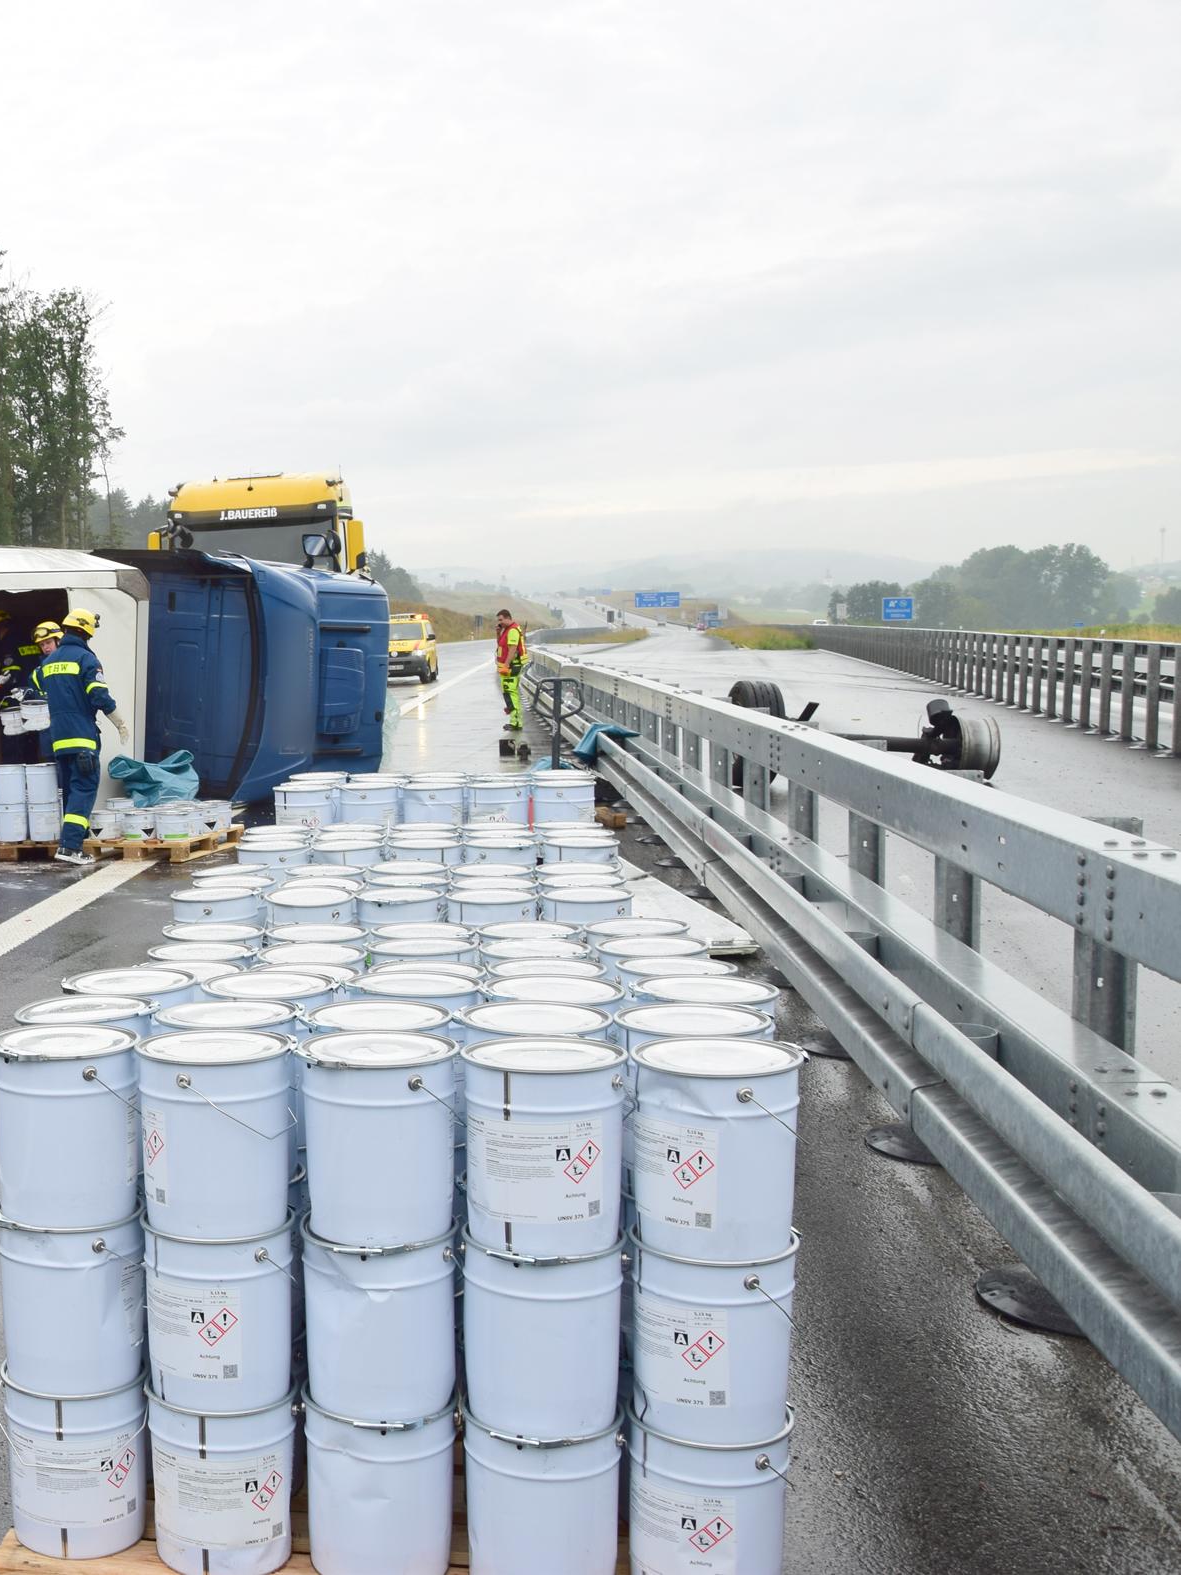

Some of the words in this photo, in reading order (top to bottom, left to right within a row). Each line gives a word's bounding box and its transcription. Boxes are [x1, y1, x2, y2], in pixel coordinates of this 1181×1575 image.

[219, 507, 278, 521] J.BAUEREIß
[46, 663, 69, 674] THW
[557, 1149, 570, 1161] A
[668, 1150, 679, 1163] A
[679, 1218, 690, 1226] 375
[192, 1312, 204, 1323] A
[675, 1332, 688, 1345] A
[246, 1482, 257, 1493] A
[683, 1518, 696, 1531] A
